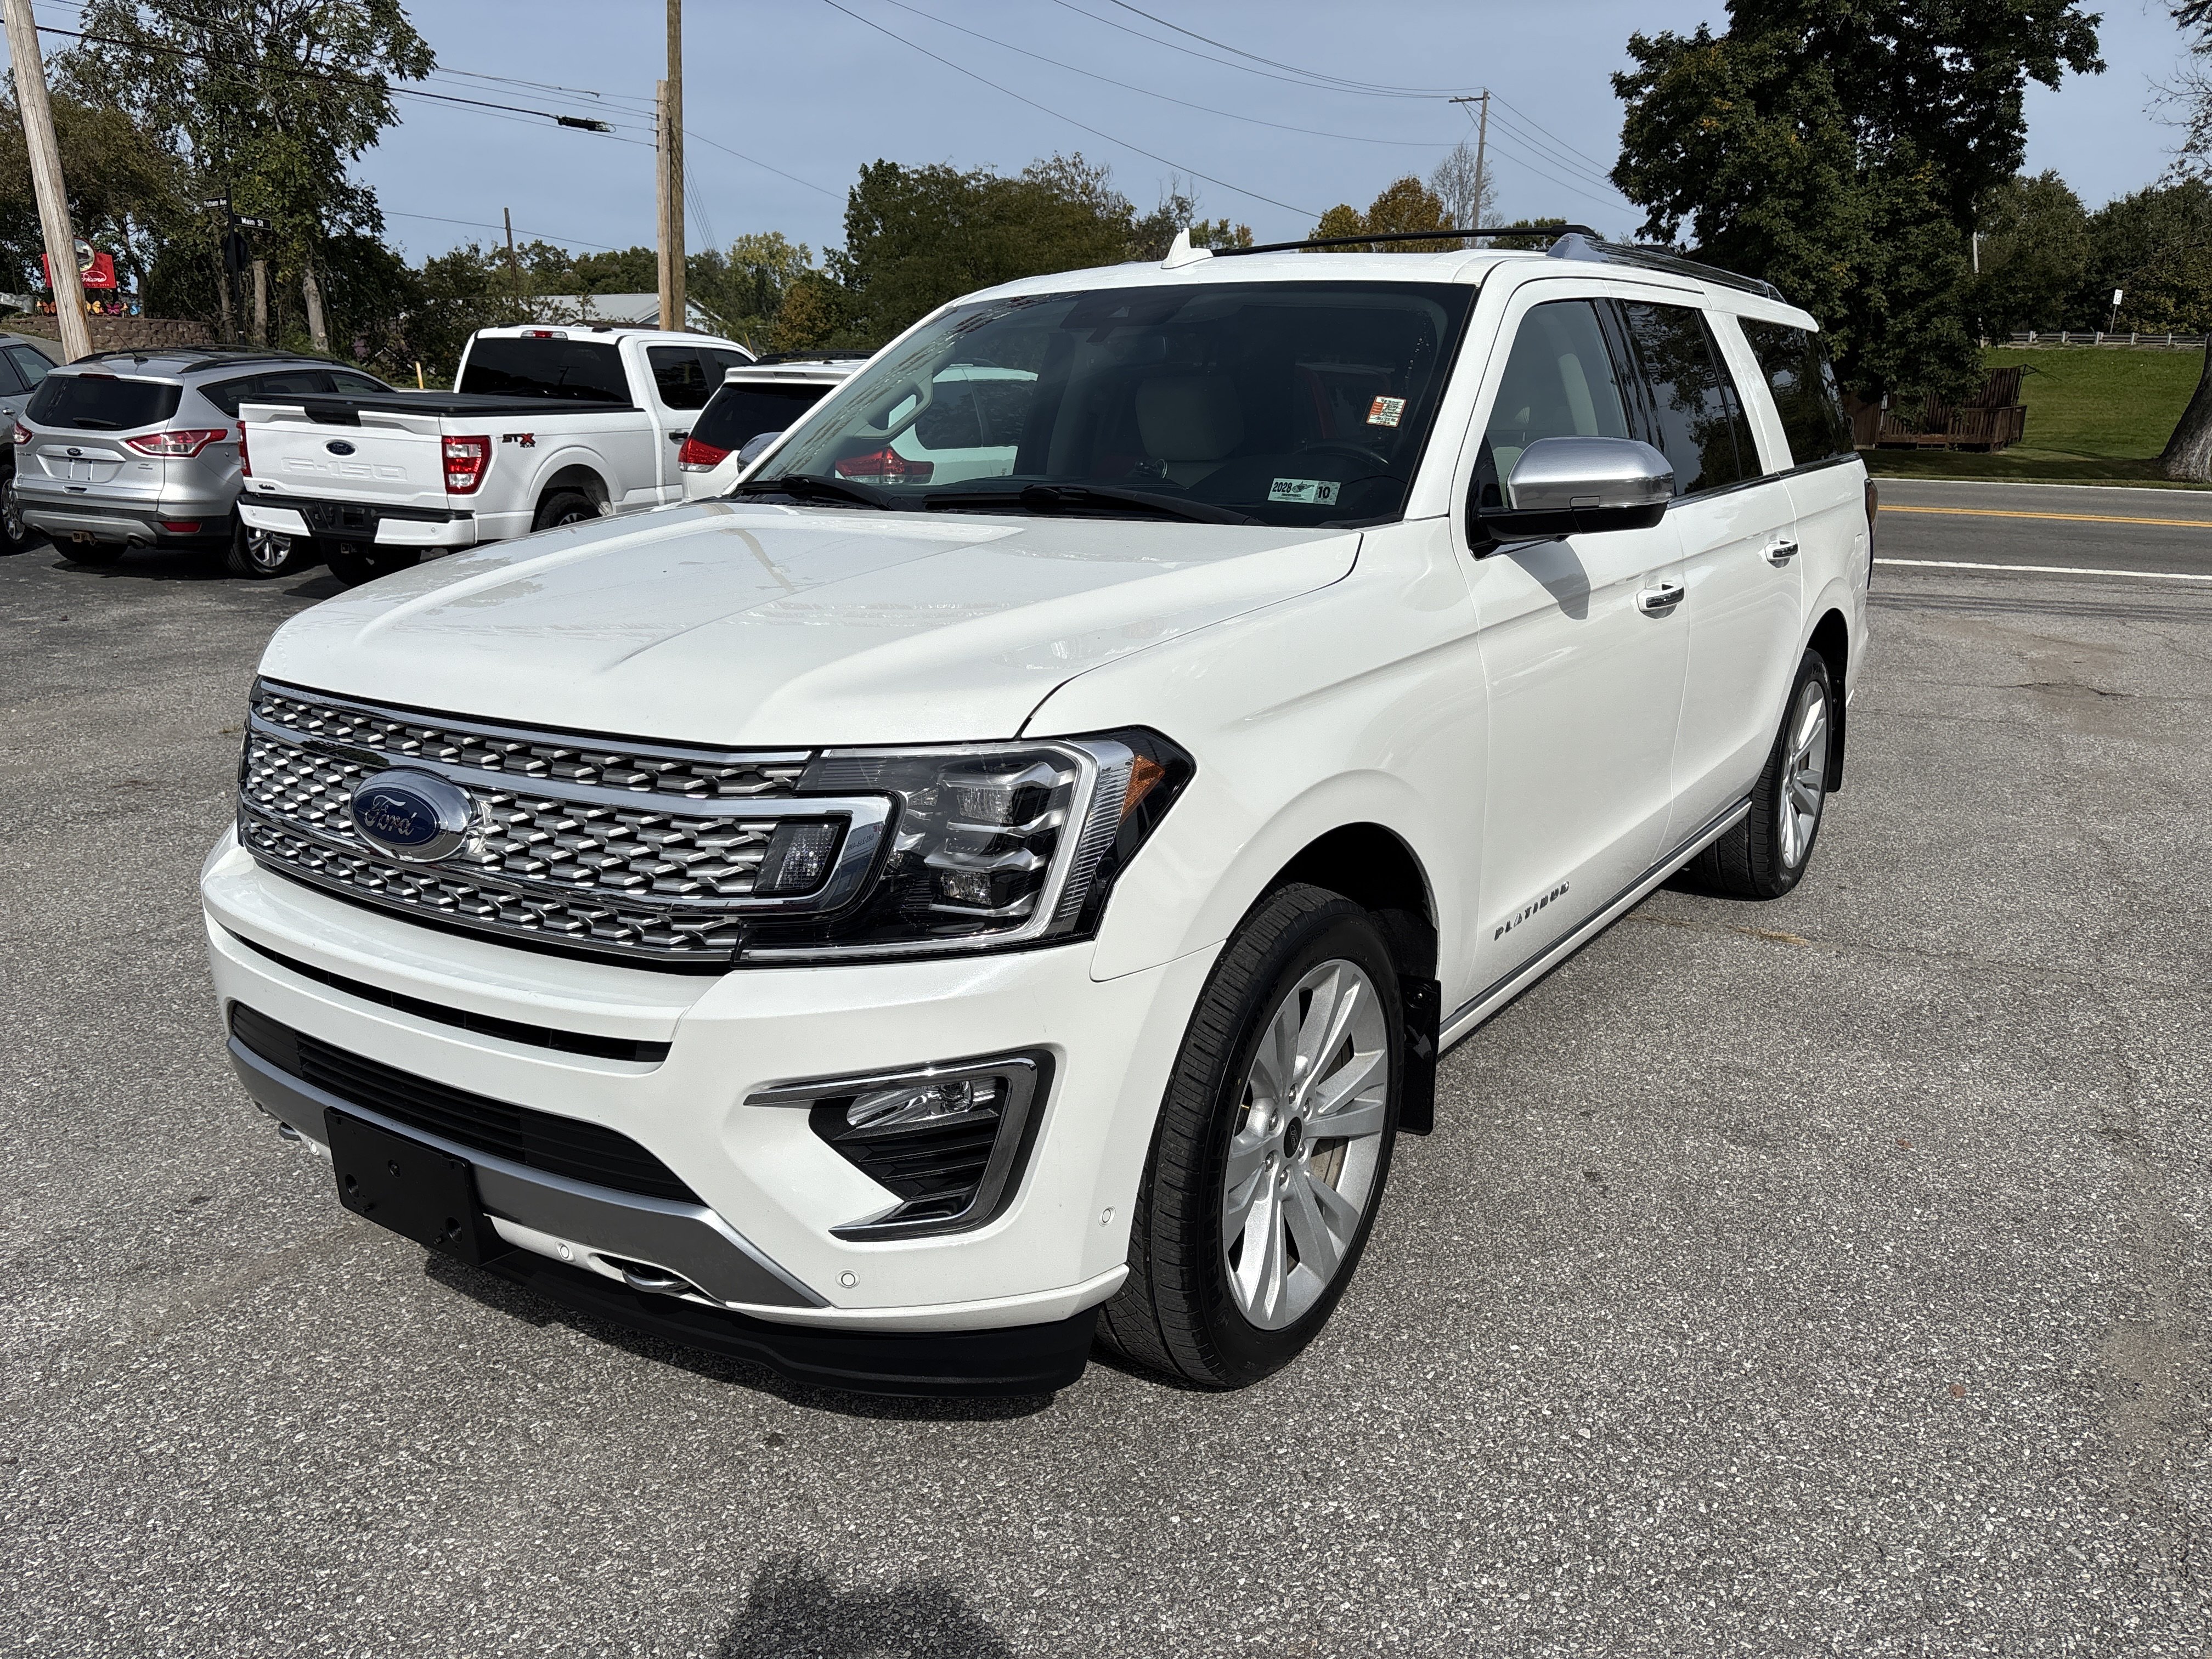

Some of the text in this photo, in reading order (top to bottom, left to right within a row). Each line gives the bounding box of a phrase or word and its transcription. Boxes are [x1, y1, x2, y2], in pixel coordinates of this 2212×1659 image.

[241, 217, 264, 227] Main St
[502, 433, 536, 444] STX
[281, 456, 408, 482] F-150
[1272, 481, 1330, 499] 2028 10
[364, 794, 418, 836] Ford
[1494, 881, 1570, 941] PLATINUM
[1303, 926, 1329, 949] SEASON
